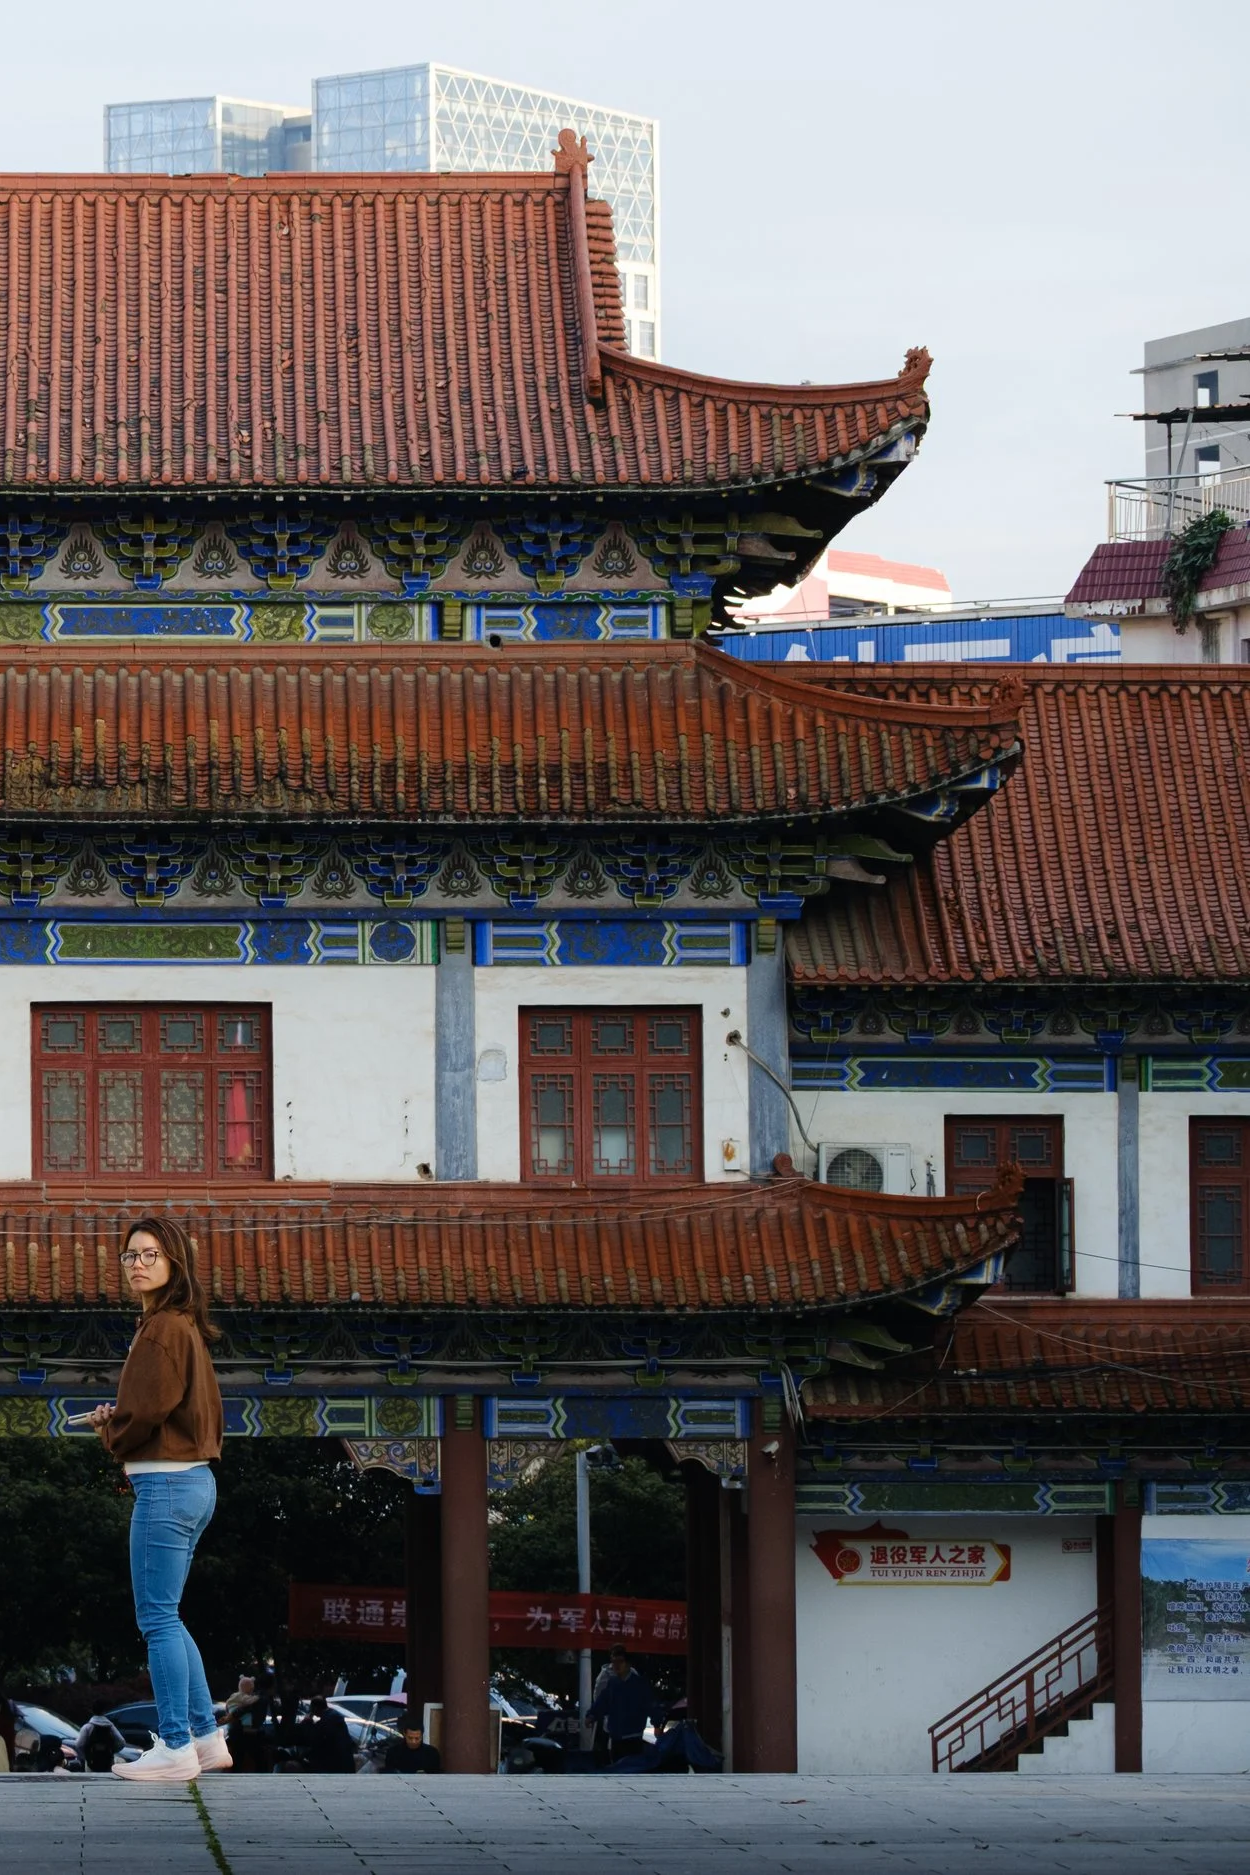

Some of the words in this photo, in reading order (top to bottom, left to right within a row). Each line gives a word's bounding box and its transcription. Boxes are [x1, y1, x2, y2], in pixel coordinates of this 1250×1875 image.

[870, 1545, 985, 1564] 退役军人之家
[903, 1570, 922, 1579] JUN
